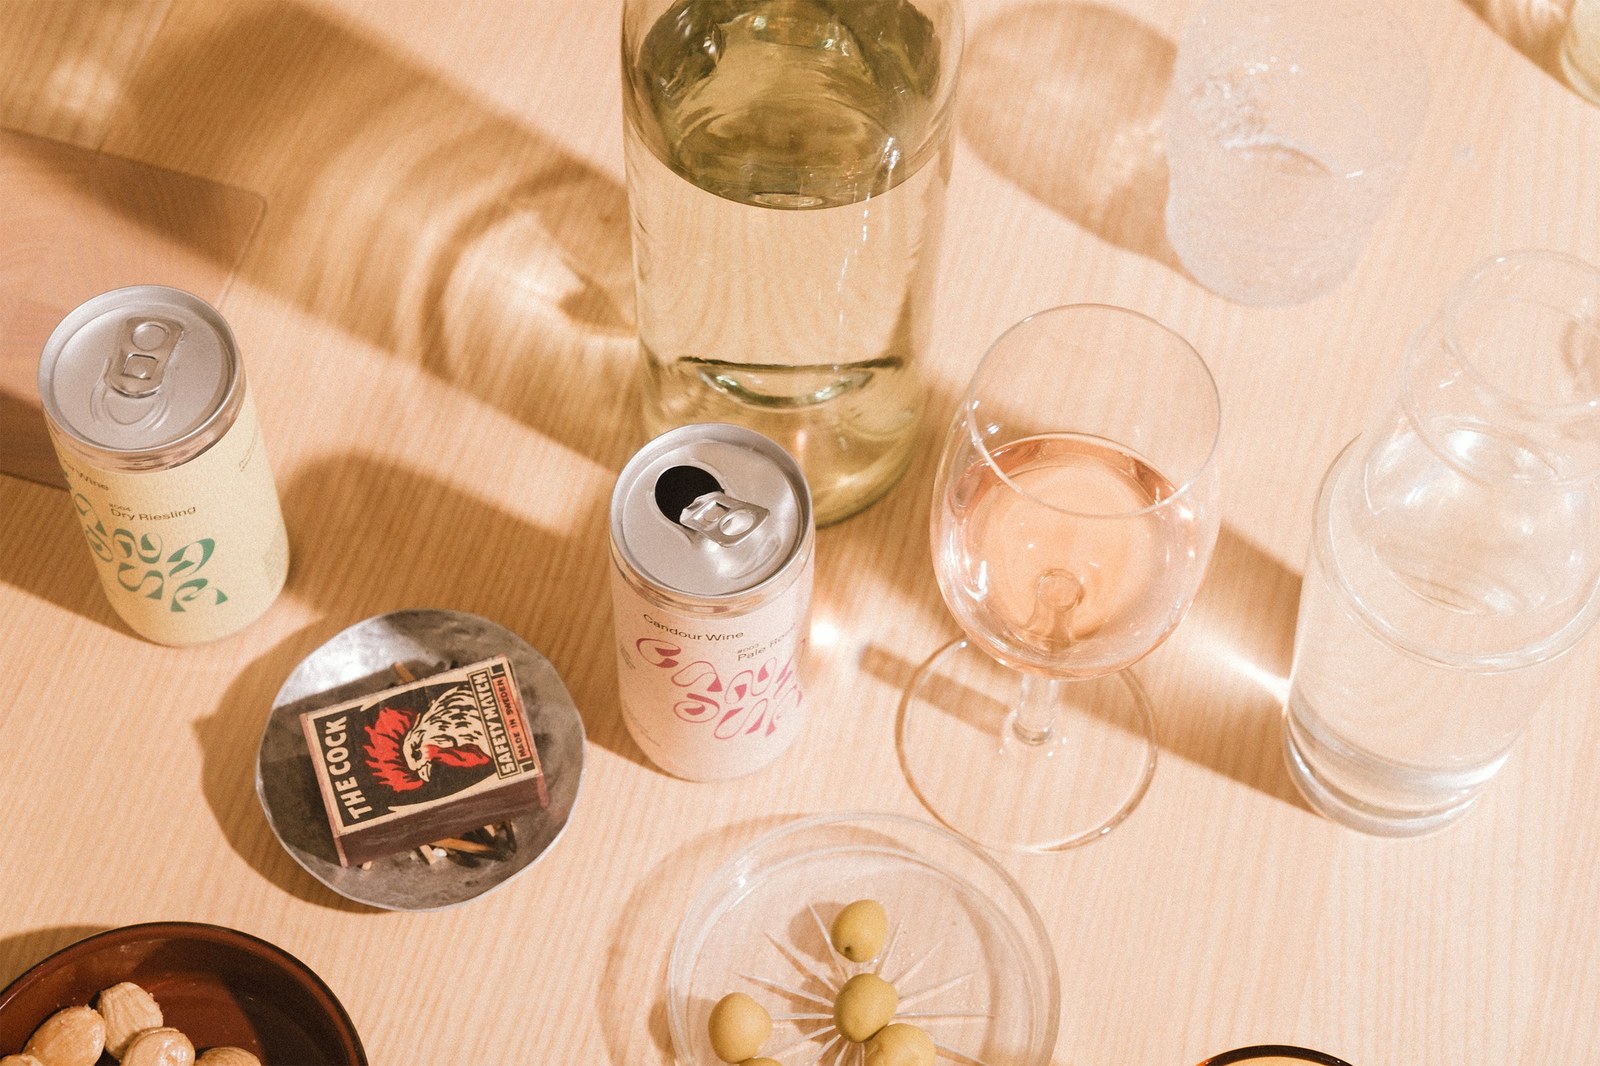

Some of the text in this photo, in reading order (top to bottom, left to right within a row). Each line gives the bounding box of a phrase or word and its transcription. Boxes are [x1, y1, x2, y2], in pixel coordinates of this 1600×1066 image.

[110, 506, 197, 521] Dry Riesling
[643, 613, 745, 641] Candour Wine
[737, 647, 766, 661] Pale
[472, 671, 517, 775] SAFETY MATCH
[496, 679, 528, 758] MADE IN SWEDEN
[324, 716, 373, 820] THE COCK
